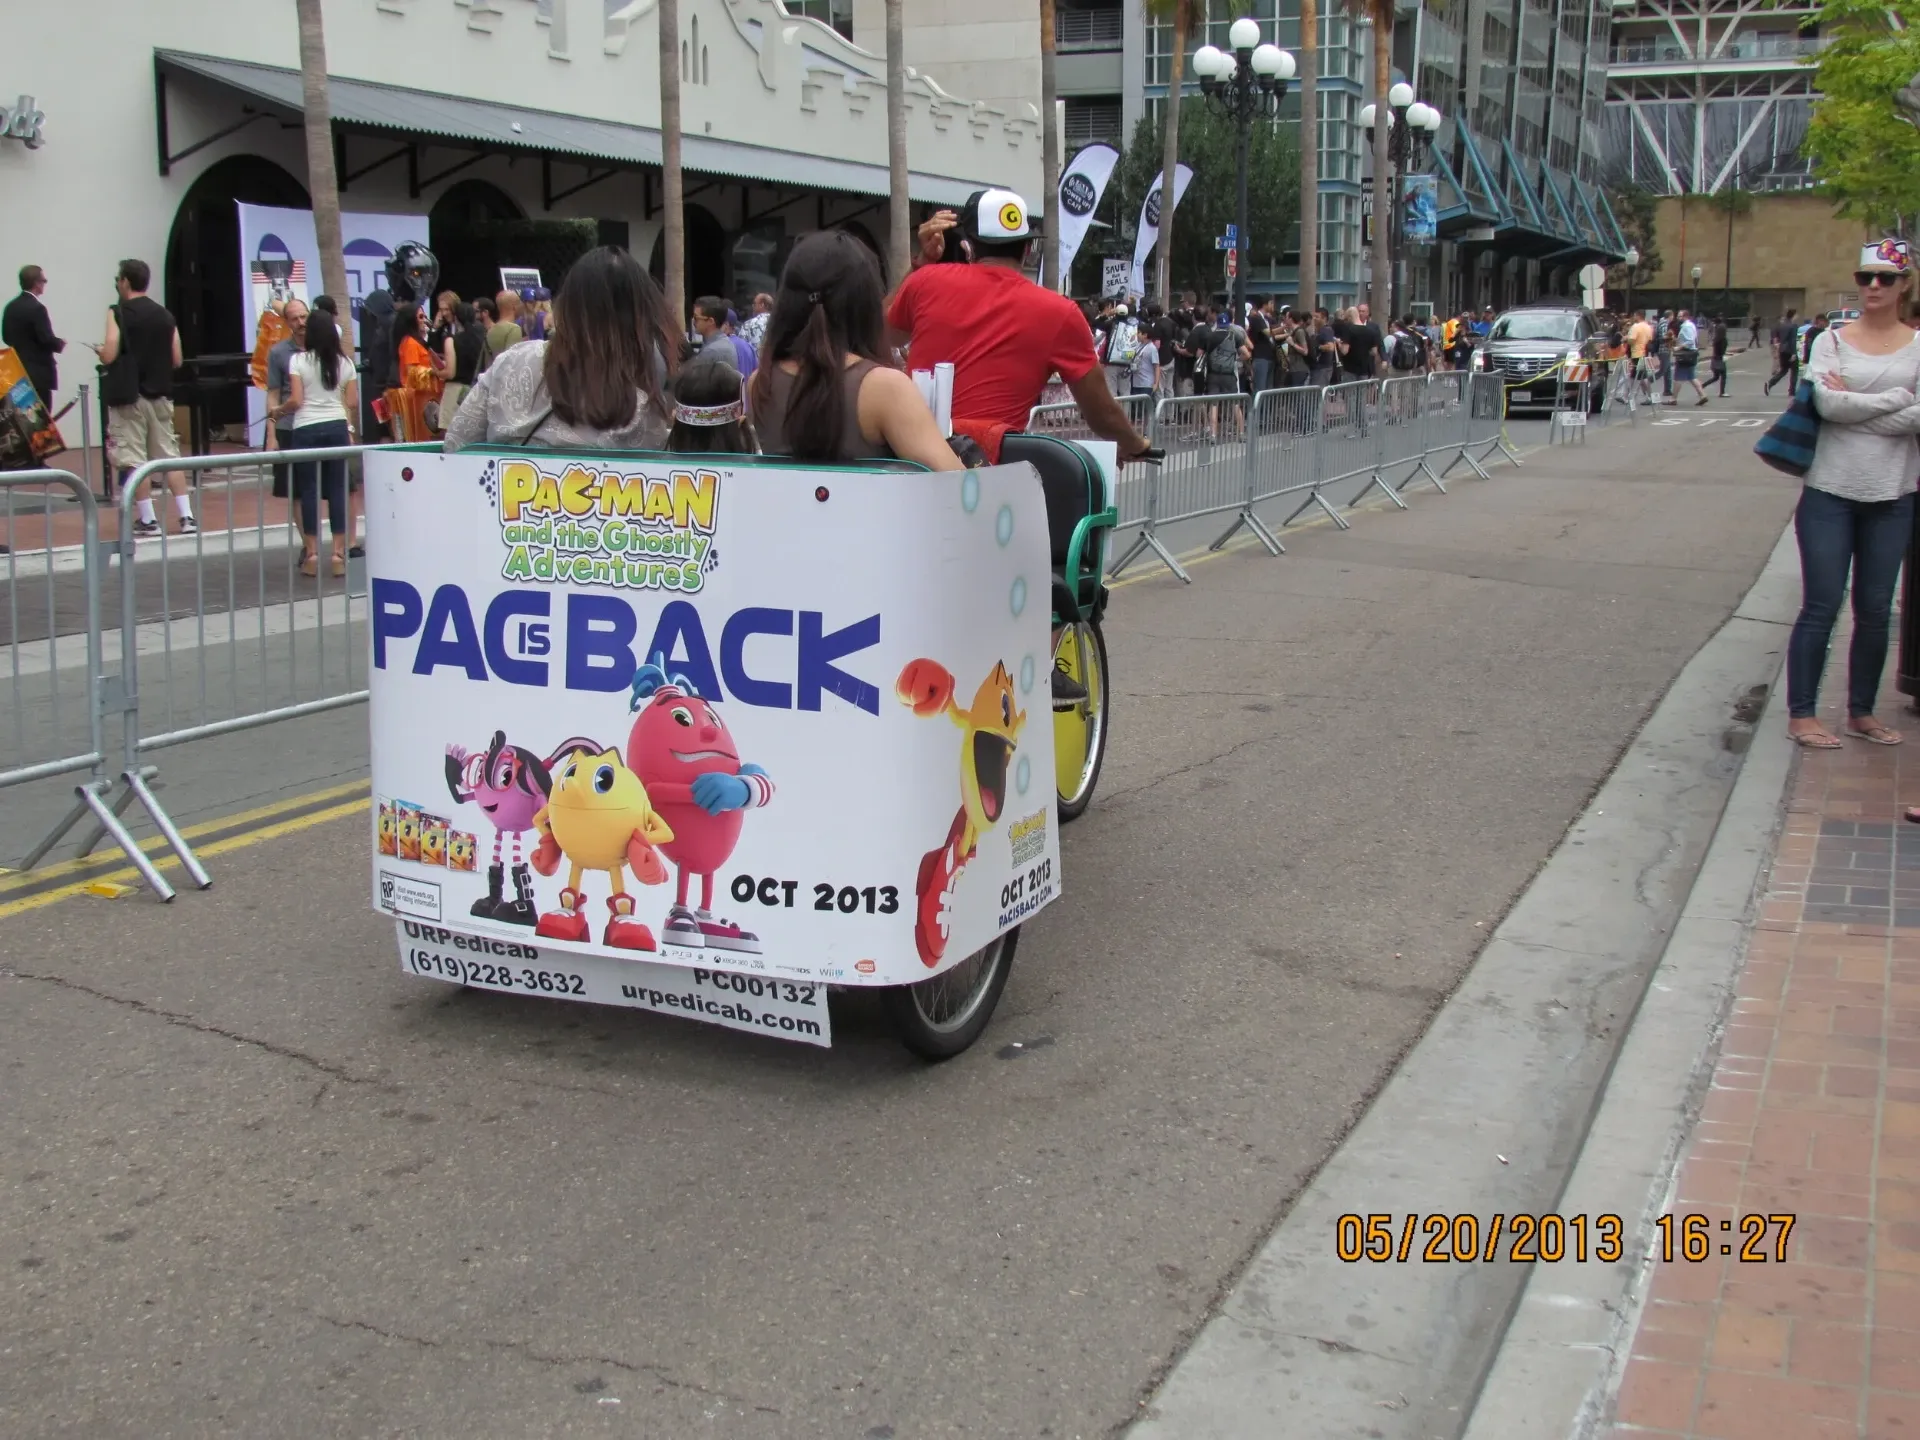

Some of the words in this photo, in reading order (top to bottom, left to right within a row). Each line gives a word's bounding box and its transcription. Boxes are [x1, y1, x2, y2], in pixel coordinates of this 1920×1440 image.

[1006, 211, 1018, 223] G
[1105, 263, 1126, 275] SAVE
[1106, 276, 1129, 287] SEALS
[501, 462, 716, 528] PAC-MAN
[505, 521, 552, 545] and
[556, 522, 598, 548] the
[602, 520, 708, 562] Ghostly
[505, 545, 702, 590] Adventures
[371, 577, 551, 687] PAC
[518, 621, 551, 656] IS
[565, 592, 882, 718] BACK
[382, 881, 394, 898] RP
[731, 874, 798, 907] OCT
[813, 882, 899, 915] 2013
[1001, 875, 1024, 909] OCT
[1028, 858, 1051, 892] 2013
[409, 948, 587, 996] (619)228-3632
[693, 967, 817, 1007] PC00132
[621, 984, 821, 1037] urpedicab.com
